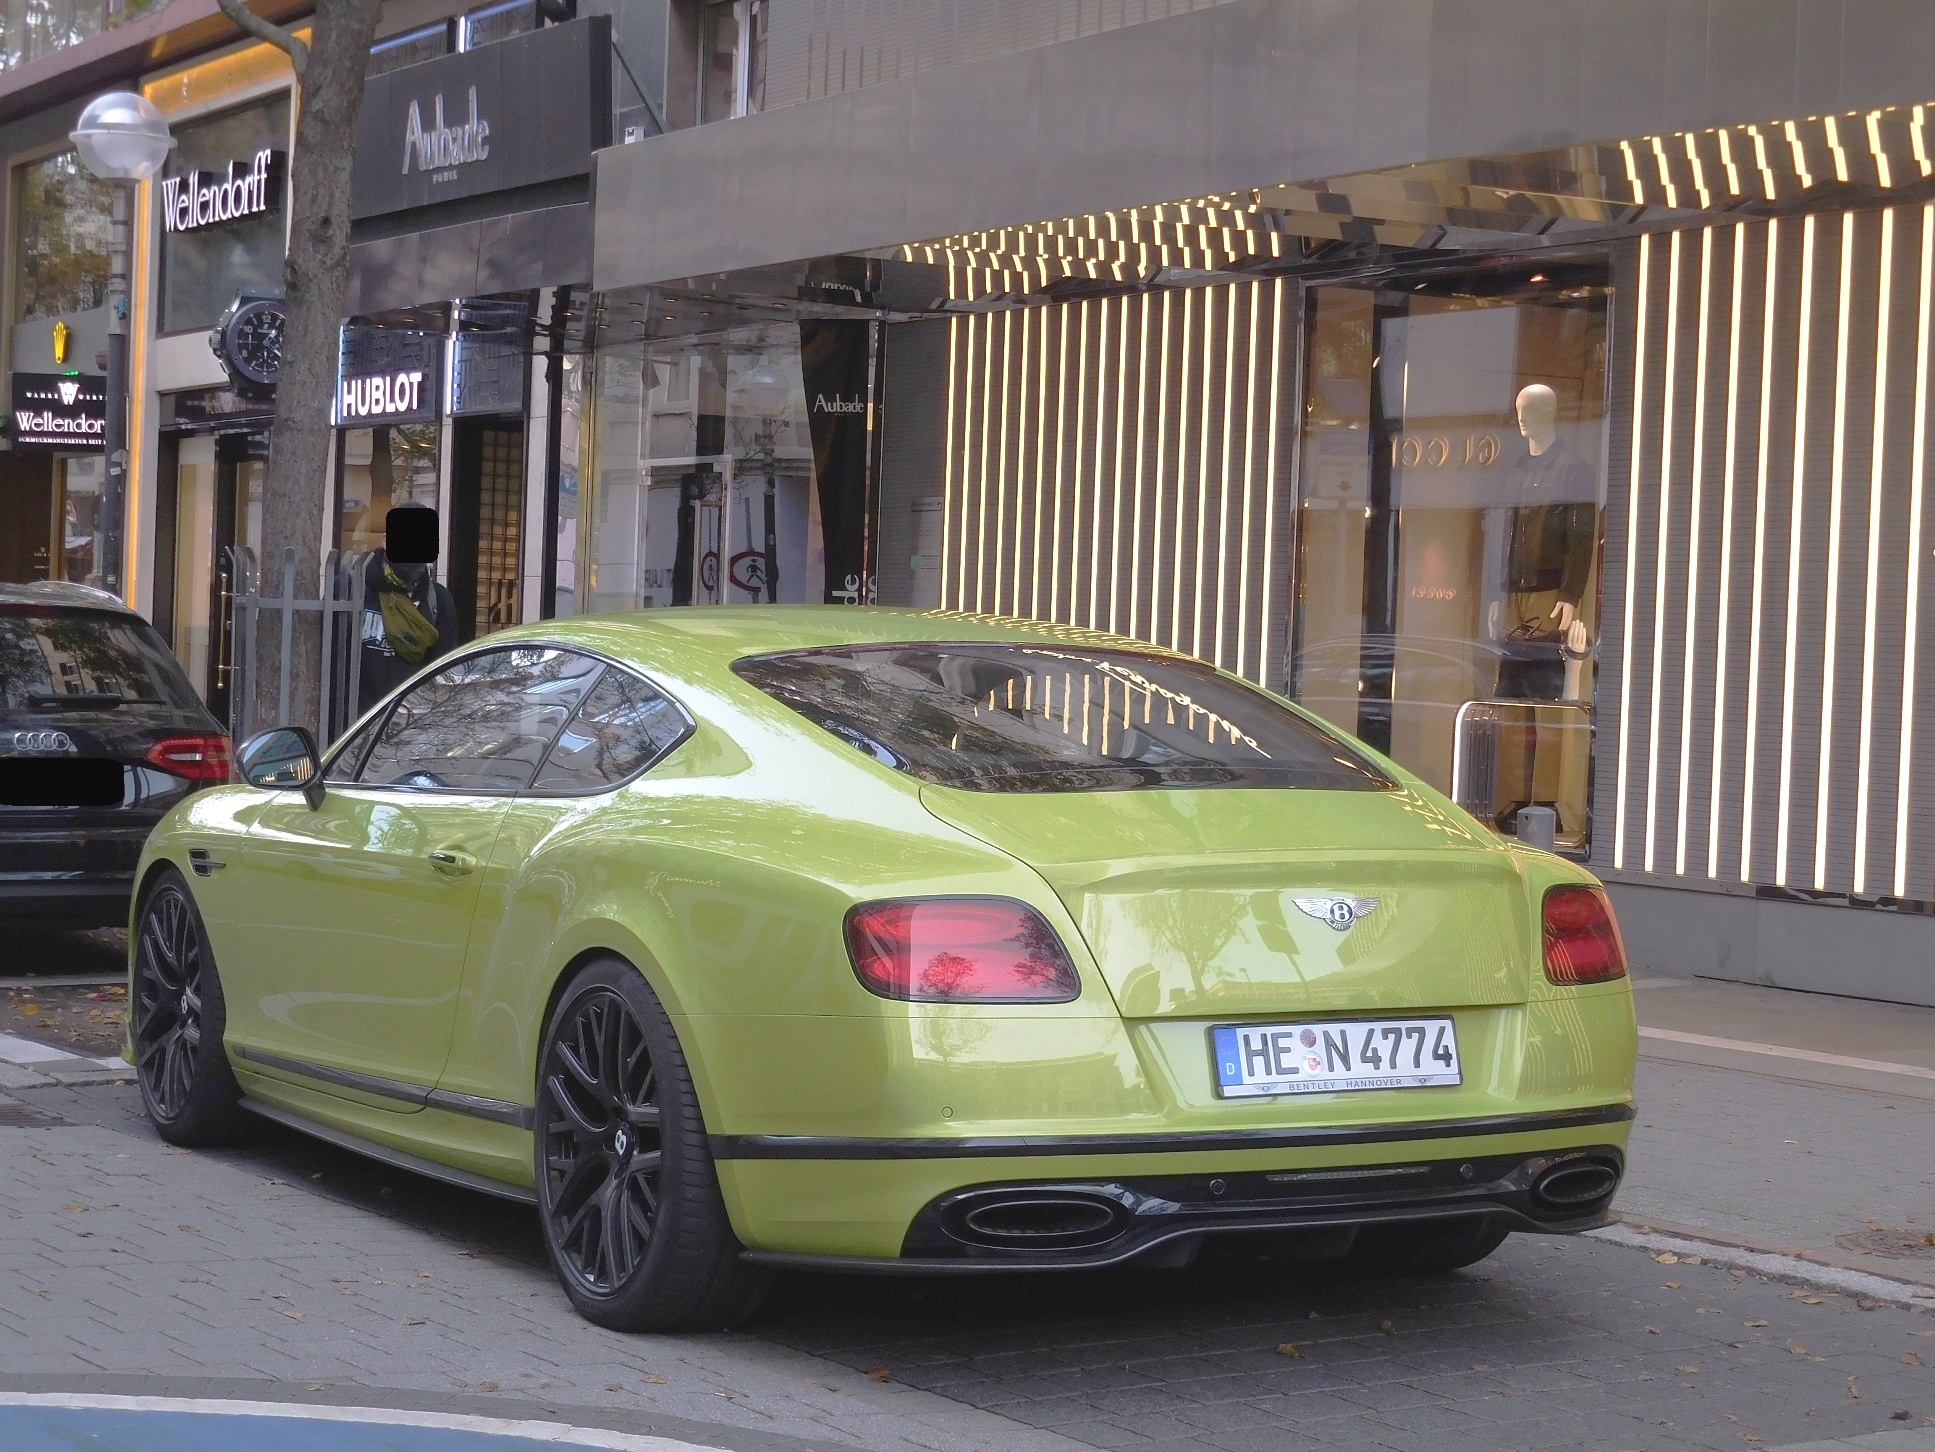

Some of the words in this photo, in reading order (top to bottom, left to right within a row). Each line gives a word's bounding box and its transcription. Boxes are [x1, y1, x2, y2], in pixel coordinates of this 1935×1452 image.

[402, 85, 489, 174] Aubade
[162, 148, 271, 233] Wellendorff
[343, 372, 422, 417] HUBLOT
[814, 393, 865, 413] Aubade
[16, 411, 105, 433] Wellendor
[1242, 1032, 1300, 1077] HE
[1322, 1029, 1352, 1073] N
[1359, 1025, 1453, 1071] 4774
[1226, 1062, 1235, 1076] D
[1288, 1081, 1336, 1092] BENTLEY
[1346, 1078, 1402, 1088] HANNOVER
[615, 1129, 627, 1157] B
